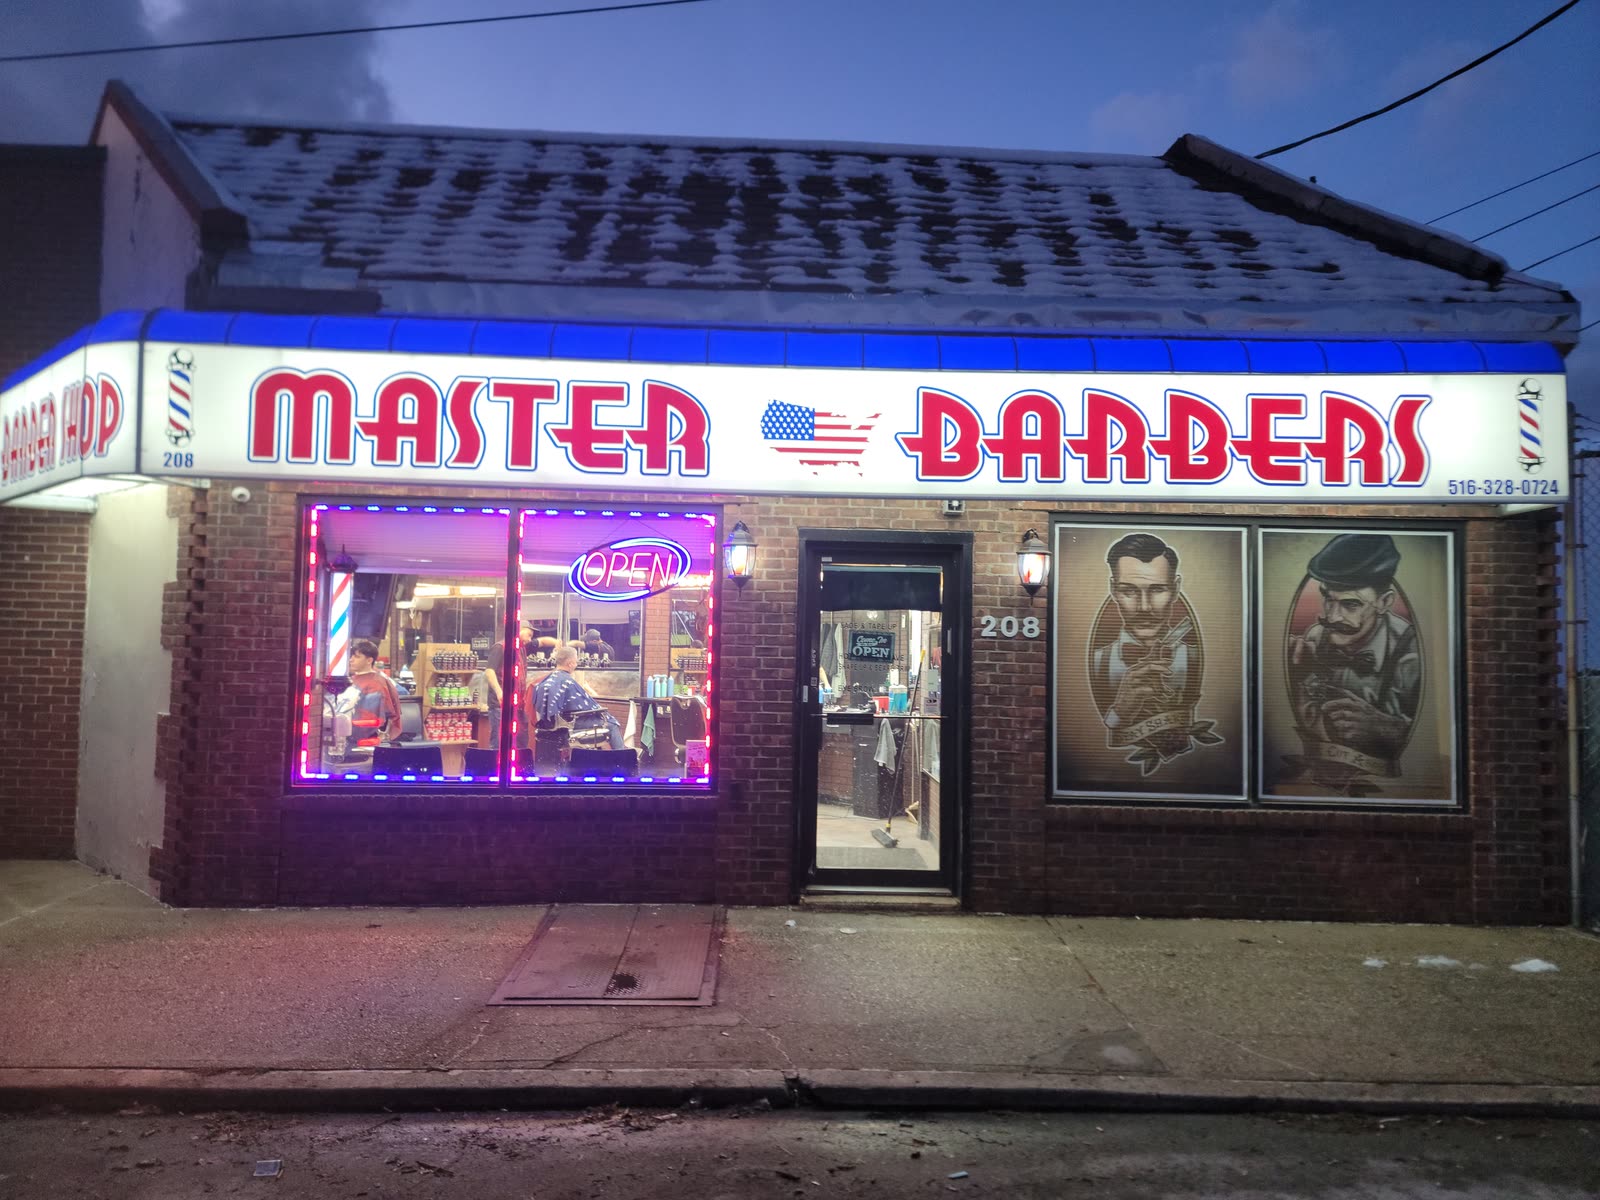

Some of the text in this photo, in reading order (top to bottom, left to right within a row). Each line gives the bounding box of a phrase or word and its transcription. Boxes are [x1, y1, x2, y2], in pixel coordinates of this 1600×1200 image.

[248, 367, 1432, 486] MASTER BARBERS
[163, 452, 194, 468] 208
[1448, 479, 1559, 495] 516-328-0724
[583, 551, 673, 587] OPEN
[868, 622, 886, 630] TAPE
[980, 615, 1041, 638] 208
[856, 635, 877, 645] Come
[877, 636, 888, 644] In
[852, 646, 890, 658] OPEN
